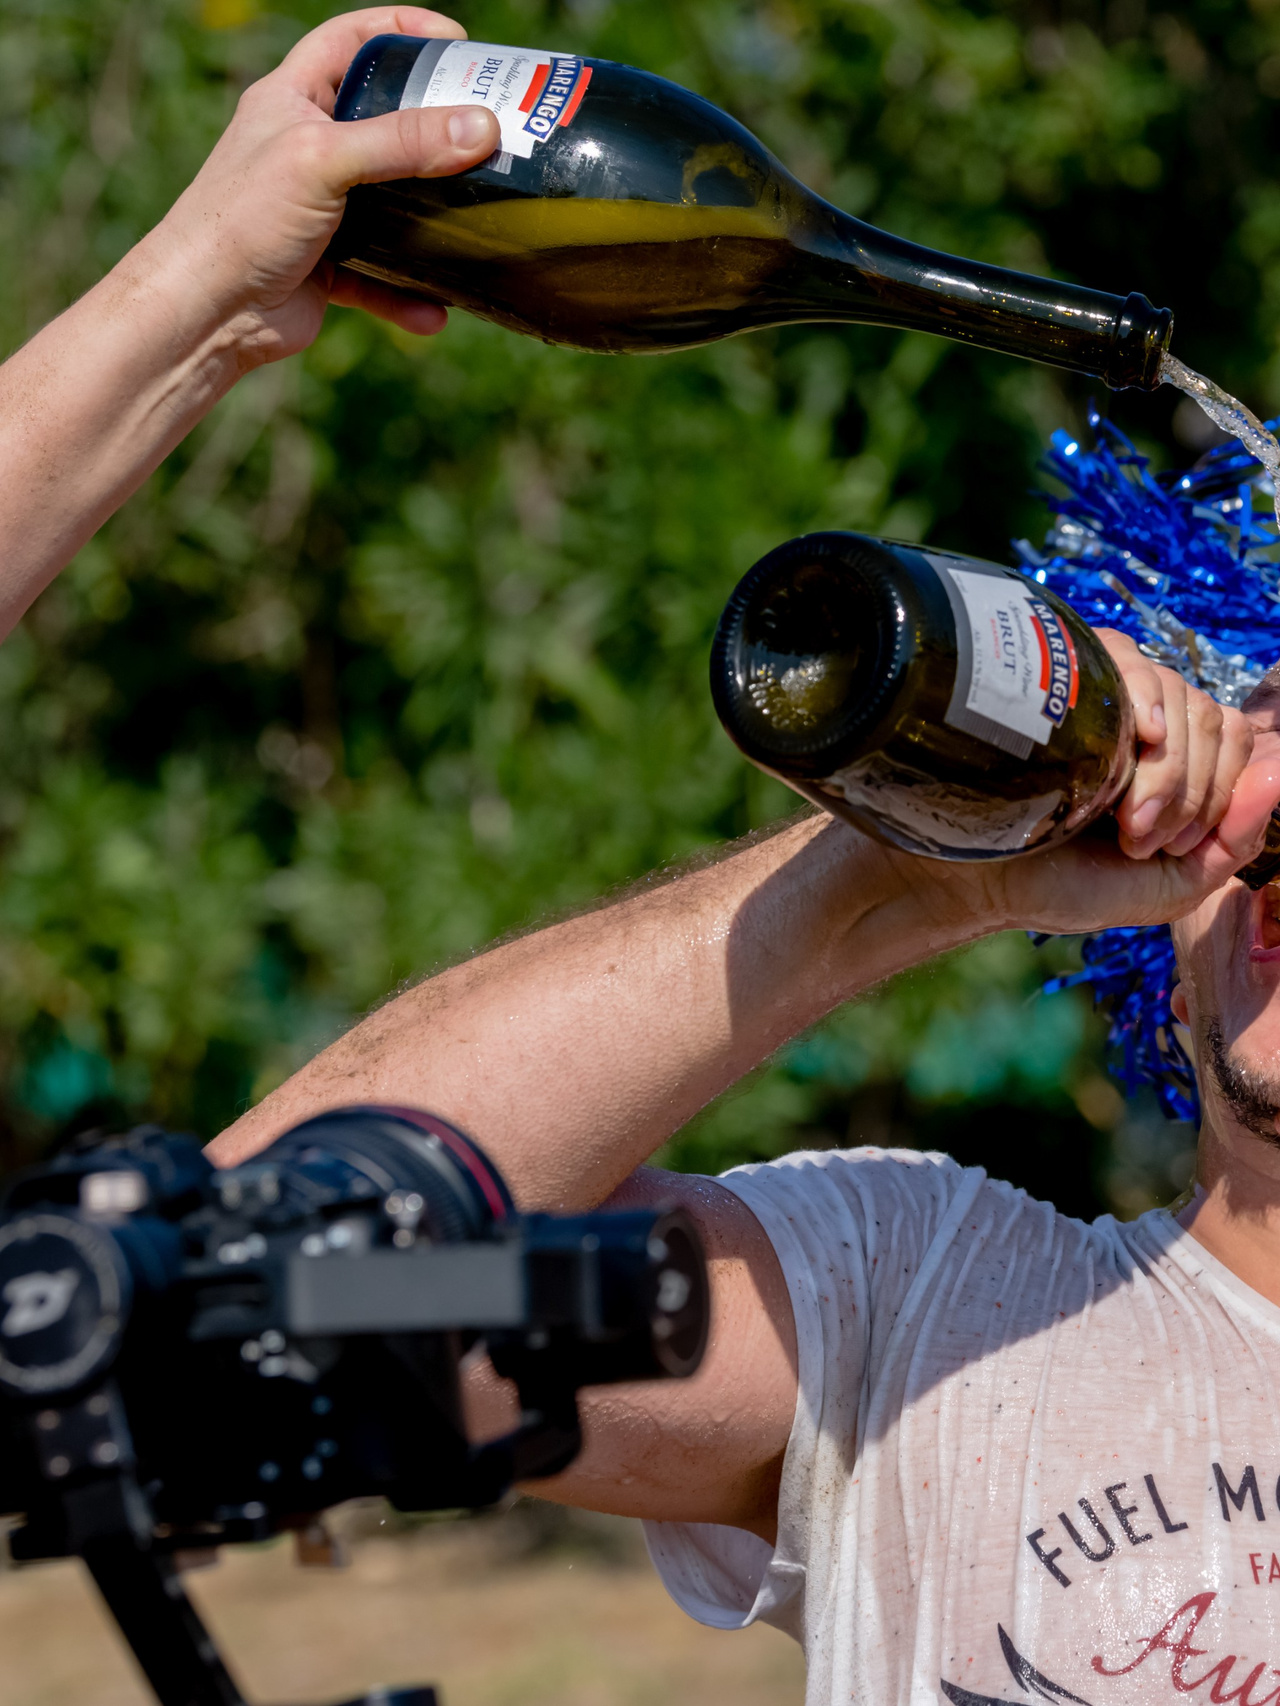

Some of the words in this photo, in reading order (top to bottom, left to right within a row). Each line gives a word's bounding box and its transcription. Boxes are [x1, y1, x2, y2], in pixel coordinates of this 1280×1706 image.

[461, 61, 478, 88] BIANCO
[471, 57, 503, 100] BRUT
[529, 60, 577, 133] MARENGO
[996, 609, 1017, 675] BRUT
[1034, 603, 1068, 715] MARENGO
[1026, 1473, 1189, 1588] FUEL
